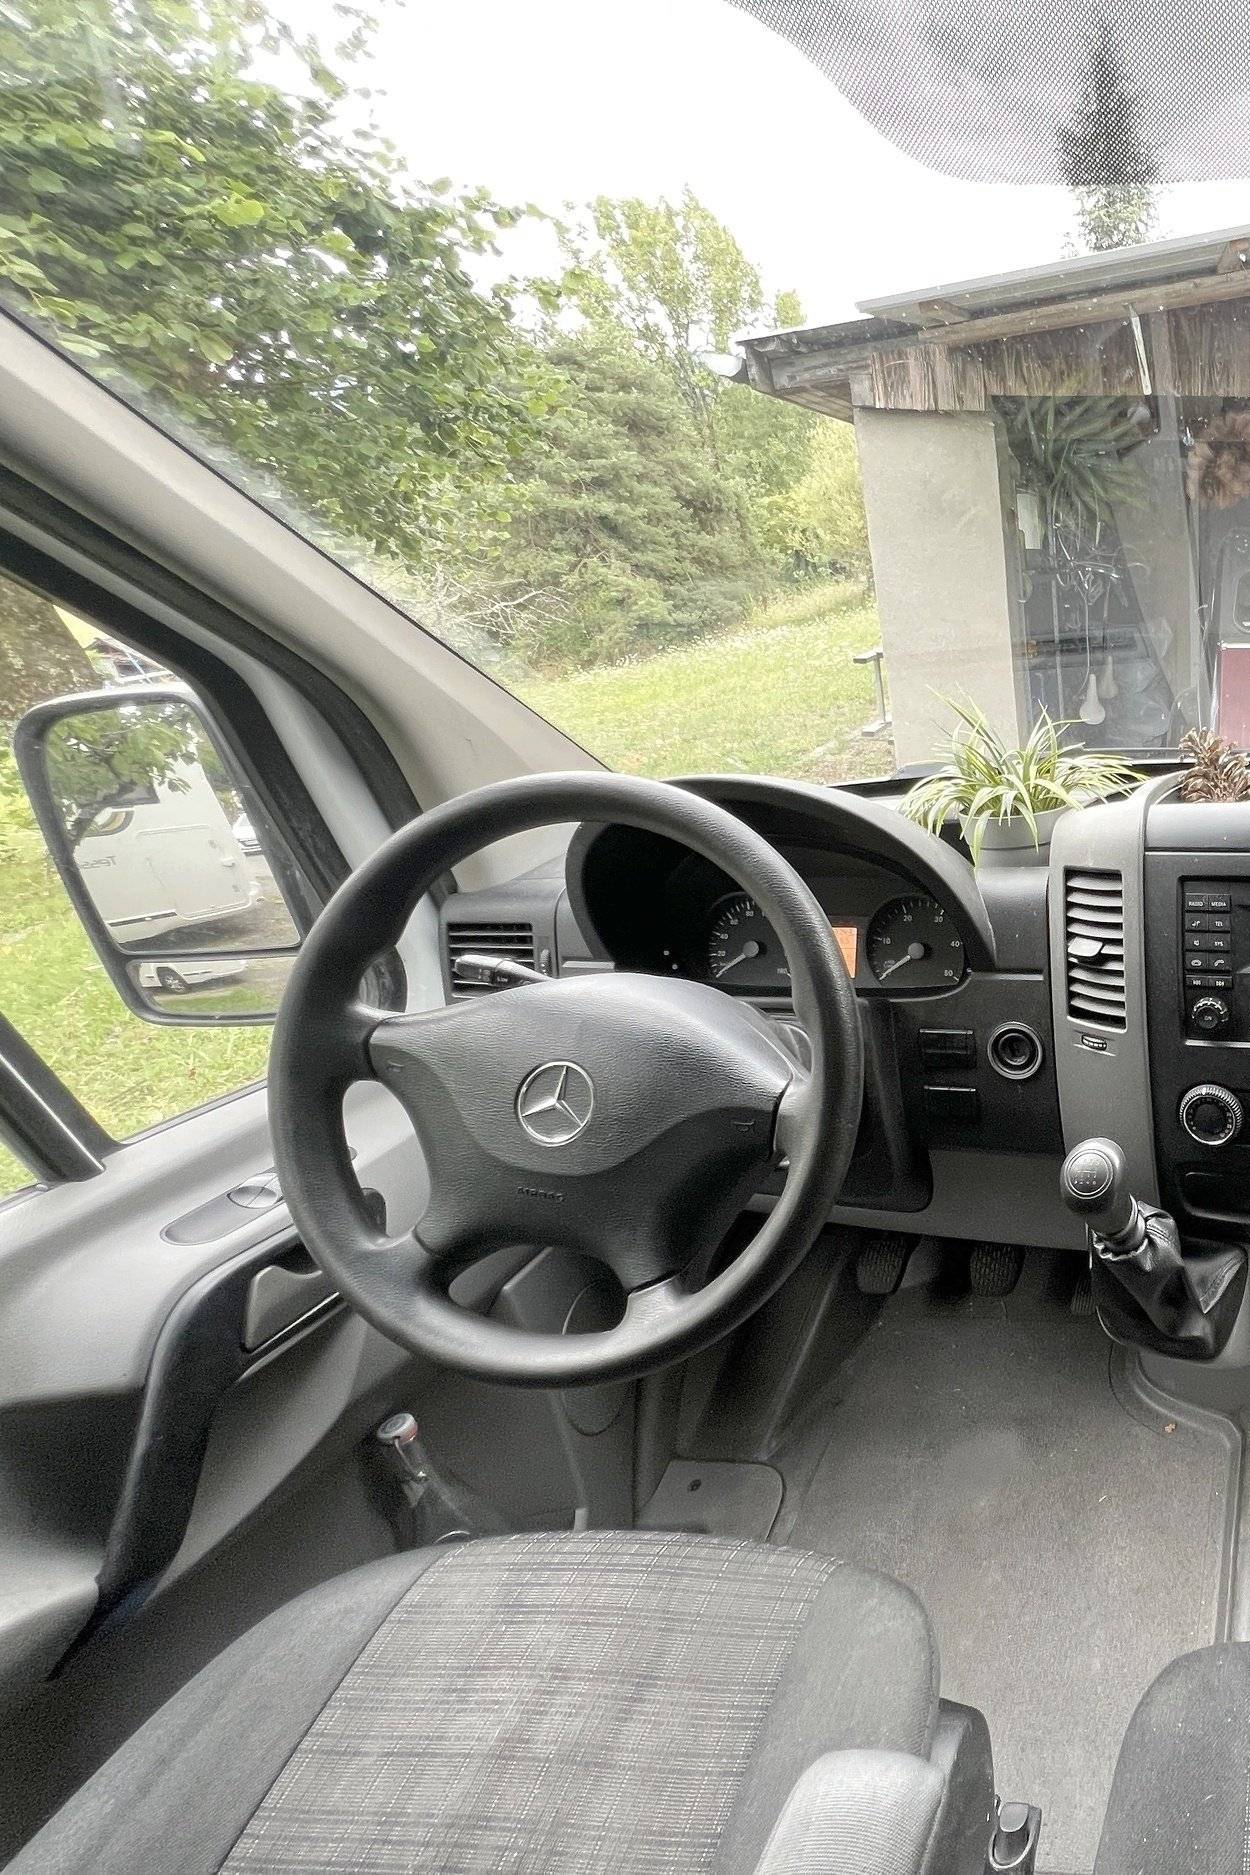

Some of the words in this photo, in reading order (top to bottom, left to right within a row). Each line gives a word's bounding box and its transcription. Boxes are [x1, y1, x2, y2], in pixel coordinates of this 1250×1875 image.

[903, 914, 913, 922] 20
[934, 915, 944, 923] 30
[882, 937, 891, 945] 10
[950, 940, 960, 948] 40
